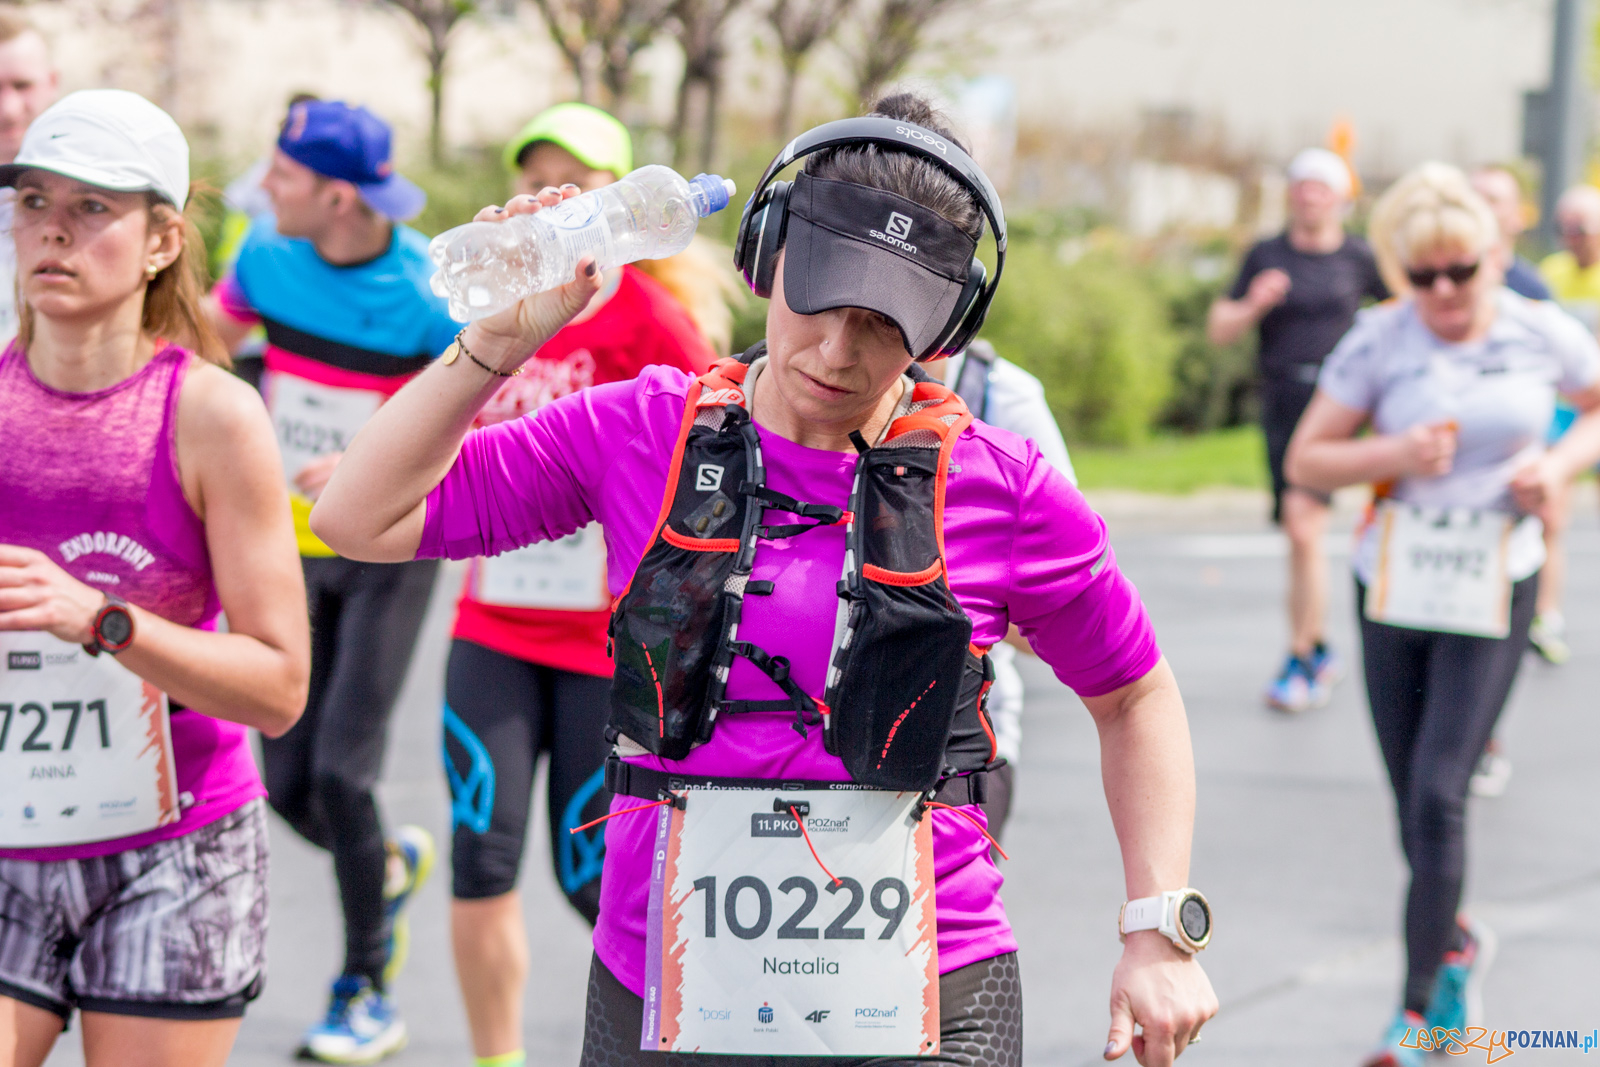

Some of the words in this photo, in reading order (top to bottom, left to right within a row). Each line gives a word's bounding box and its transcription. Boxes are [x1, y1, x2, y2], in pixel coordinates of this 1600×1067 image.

[896, 125, 948, 154] beats
[869, 229, 917, 254] salomon
[58, 531, 155, 572] ENDORFINY
[30, 765, 77, 781] ANNA
[660, 804, 669, 839] 15.04.20
[656, 850, 665, 861] D
[693, 875, 911, 940] 10229
[763, 957, 840, 975] Natalia
[804, 1009, 831, 1023] 4F
